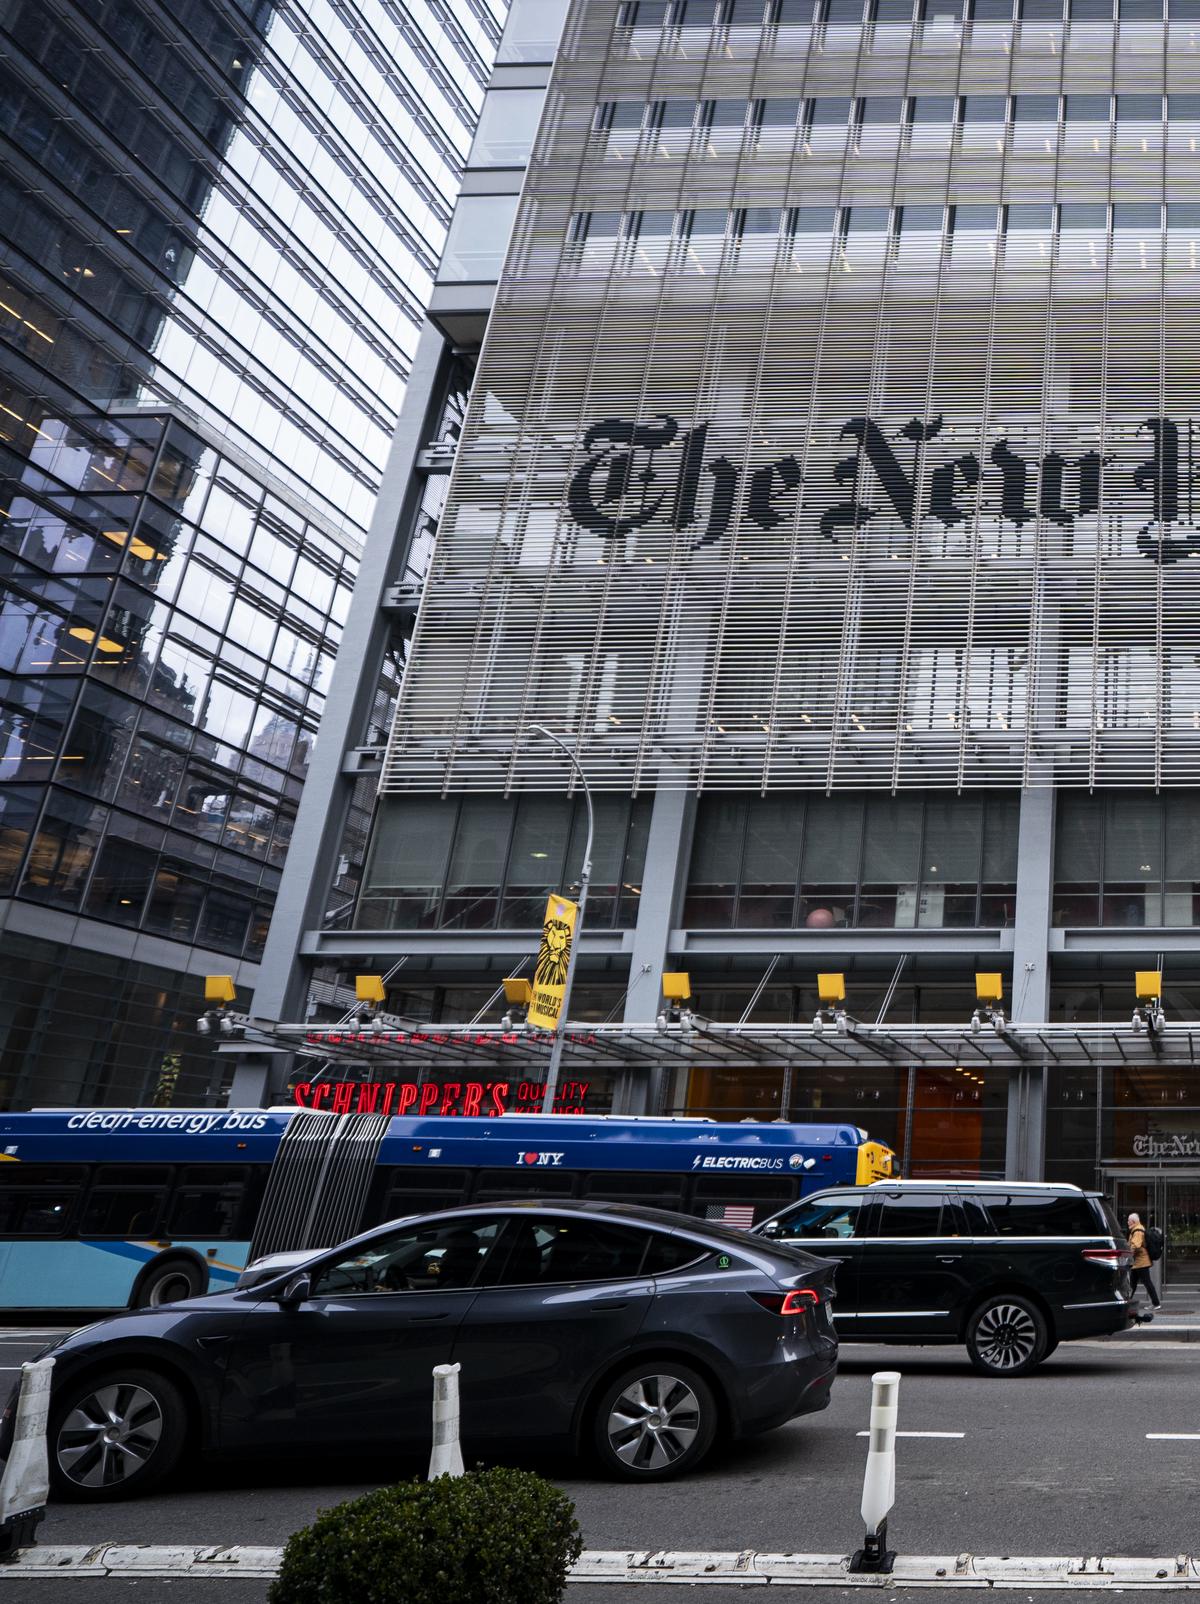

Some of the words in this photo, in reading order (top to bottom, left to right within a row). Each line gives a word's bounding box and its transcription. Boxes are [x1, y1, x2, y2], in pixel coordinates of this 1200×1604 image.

[567, 413, 801, 551] The
[820, 412, 1115, 545] New
[294, 1082, 510, 1117] SCHNIPPER'S
[67, 1111, 221, 1133] clean-energy
[223, 1111, 269, 1129] bus
[1132, 1134, 1167, 1158] The
[537, 1152, 564, 1165] NY
[702, 1156, 784, 1169] ELECTRICBUS
